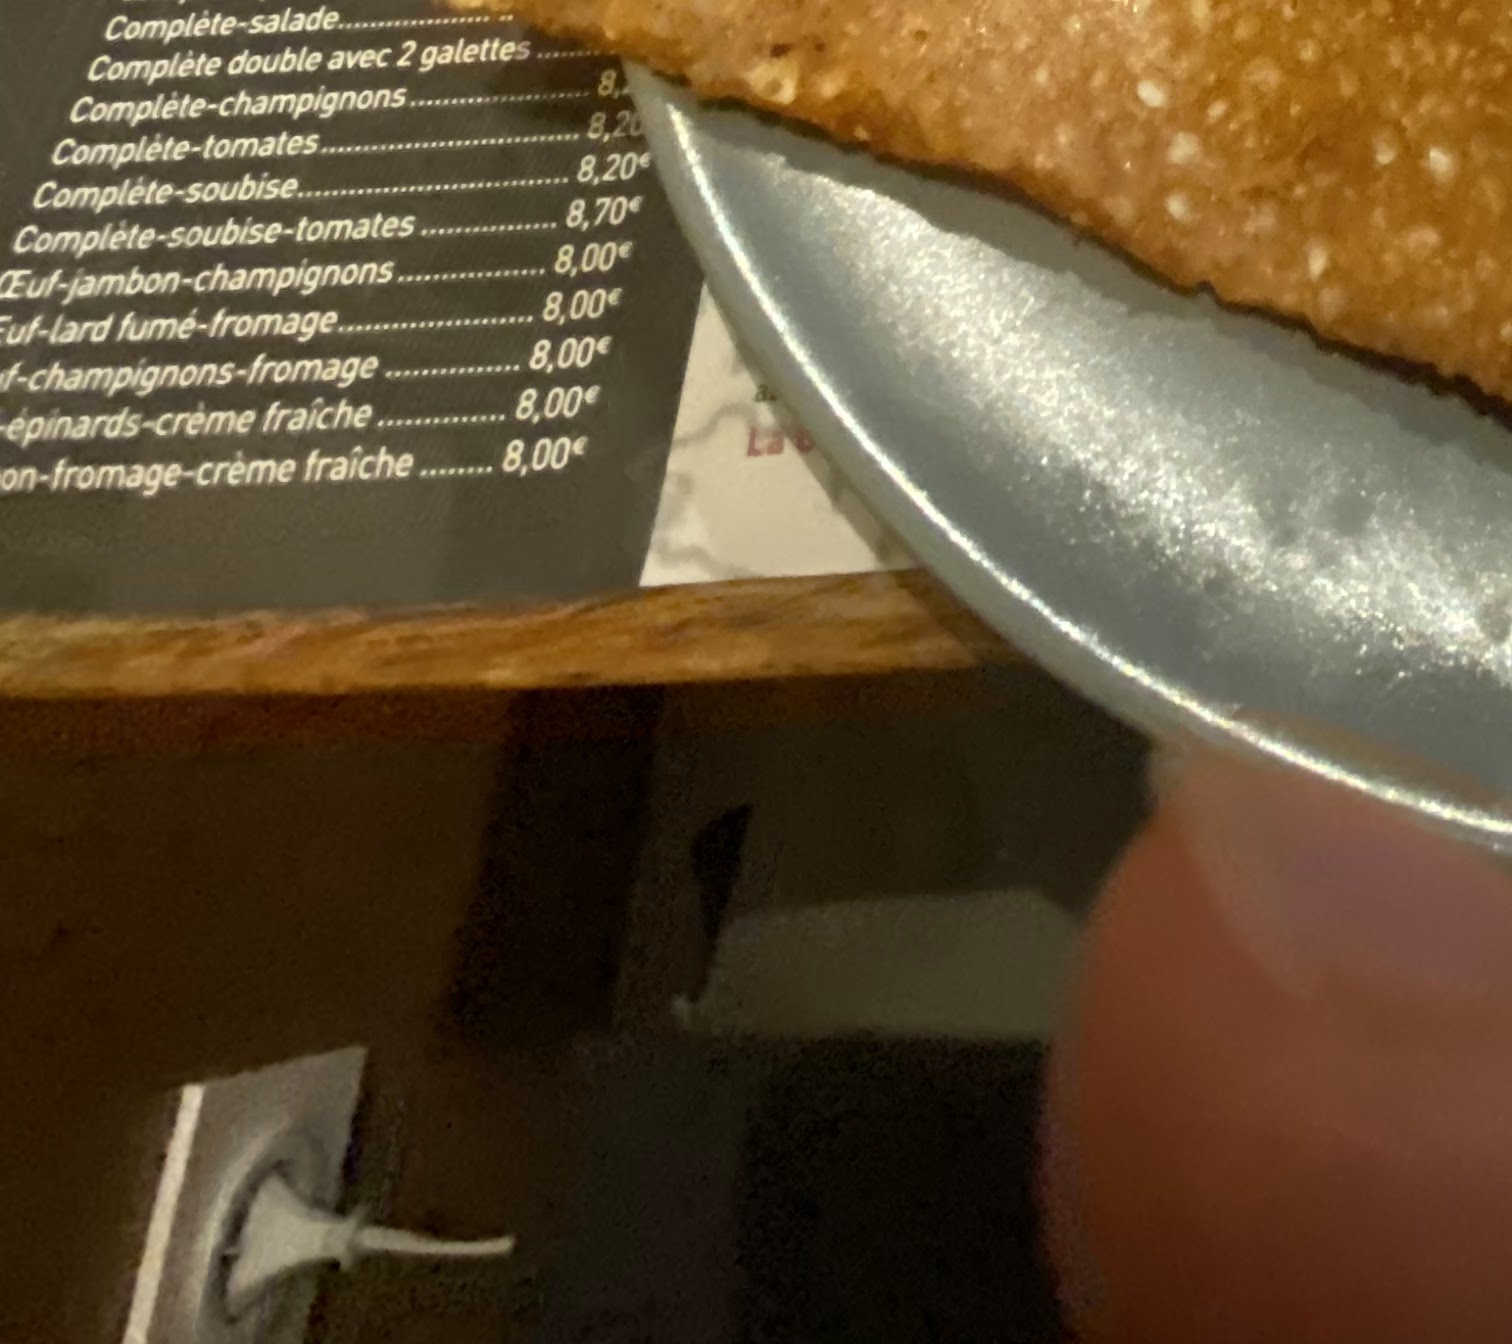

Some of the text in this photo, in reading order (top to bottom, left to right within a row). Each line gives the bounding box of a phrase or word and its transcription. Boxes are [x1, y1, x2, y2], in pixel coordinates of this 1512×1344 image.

[105, 7, 339, 43] Complète-salade
[87, 38, 532, 86] Complète double avec 2 galettes
[70, 85, 407, 128] Complète-champignons
[52, 131, 319, 170] Complète-tomates
[33, 152, 652, 216] Complète-soubise 8,20€
[13, 196, 642, 256] Complète-soubise-tomates 8,70€
[554, 240, 633, 276] 8,00€
[116, 287, 622, 343] fumé-fromage 8,00€
[529, 335, 611, 371] 8,00€
[261, 384, 600, 433] fraîche 8,00€
[304, 436, 588, 481] fraîche 8,00€
